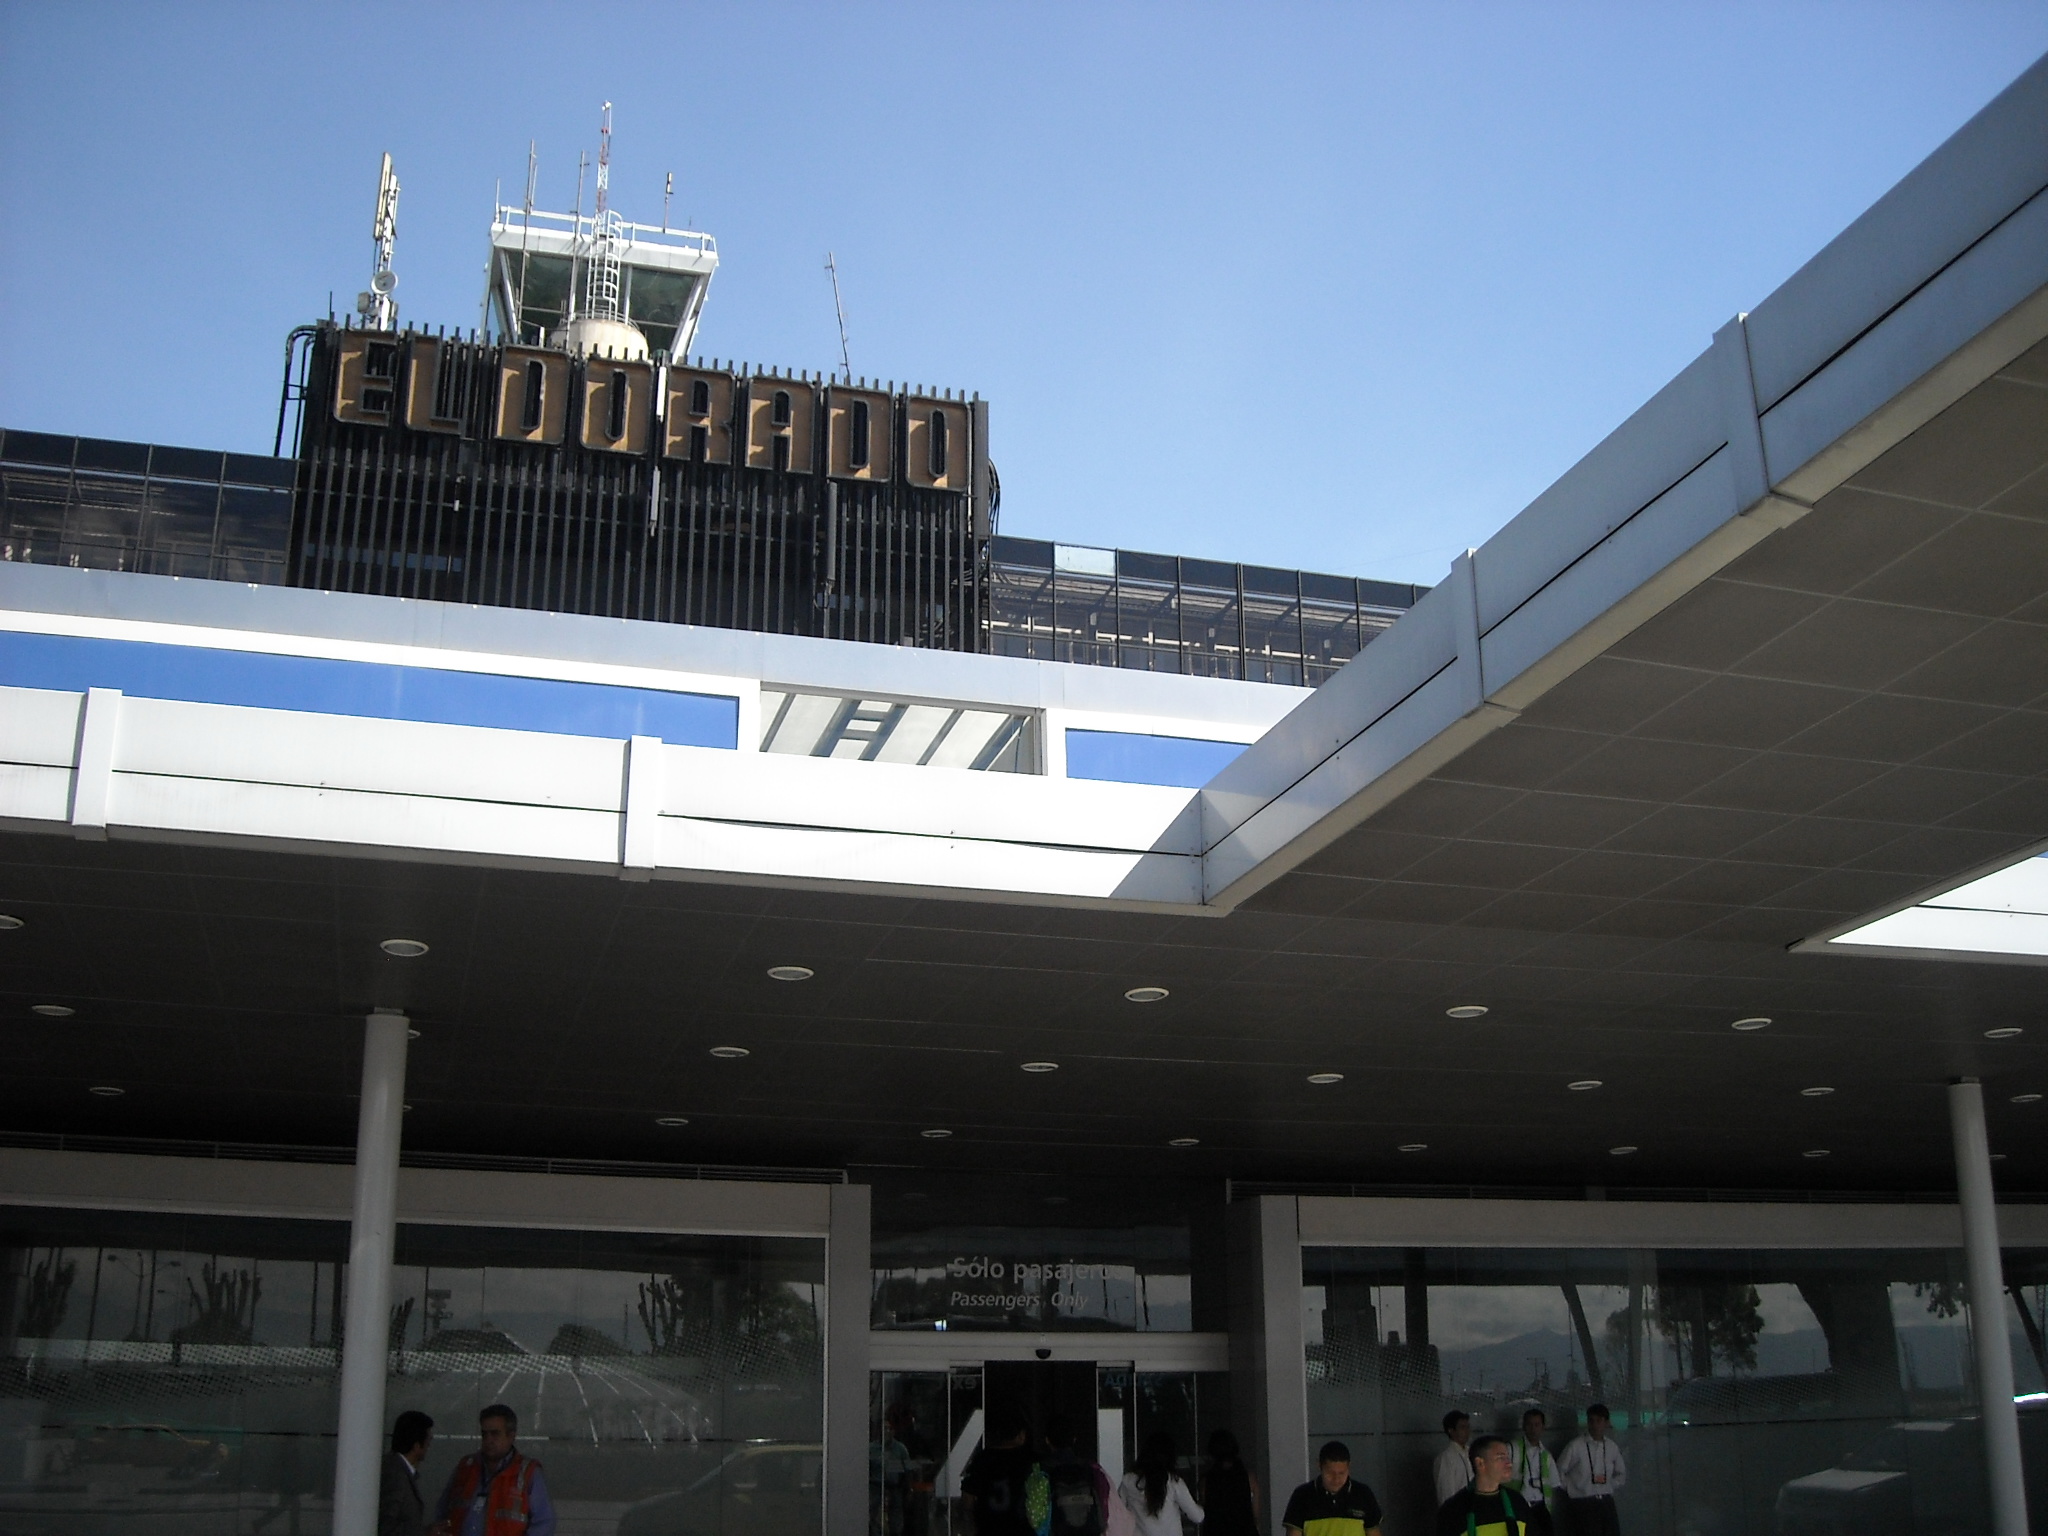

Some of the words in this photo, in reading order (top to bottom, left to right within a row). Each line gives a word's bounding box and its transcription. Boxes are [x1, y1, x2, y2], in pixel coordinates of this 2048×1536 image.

[953, 1256, 1004, 1278] Sólo
[951, 1291, 1040, 1310] Passengers
[1051, 1292, 1088, 1309] Only
